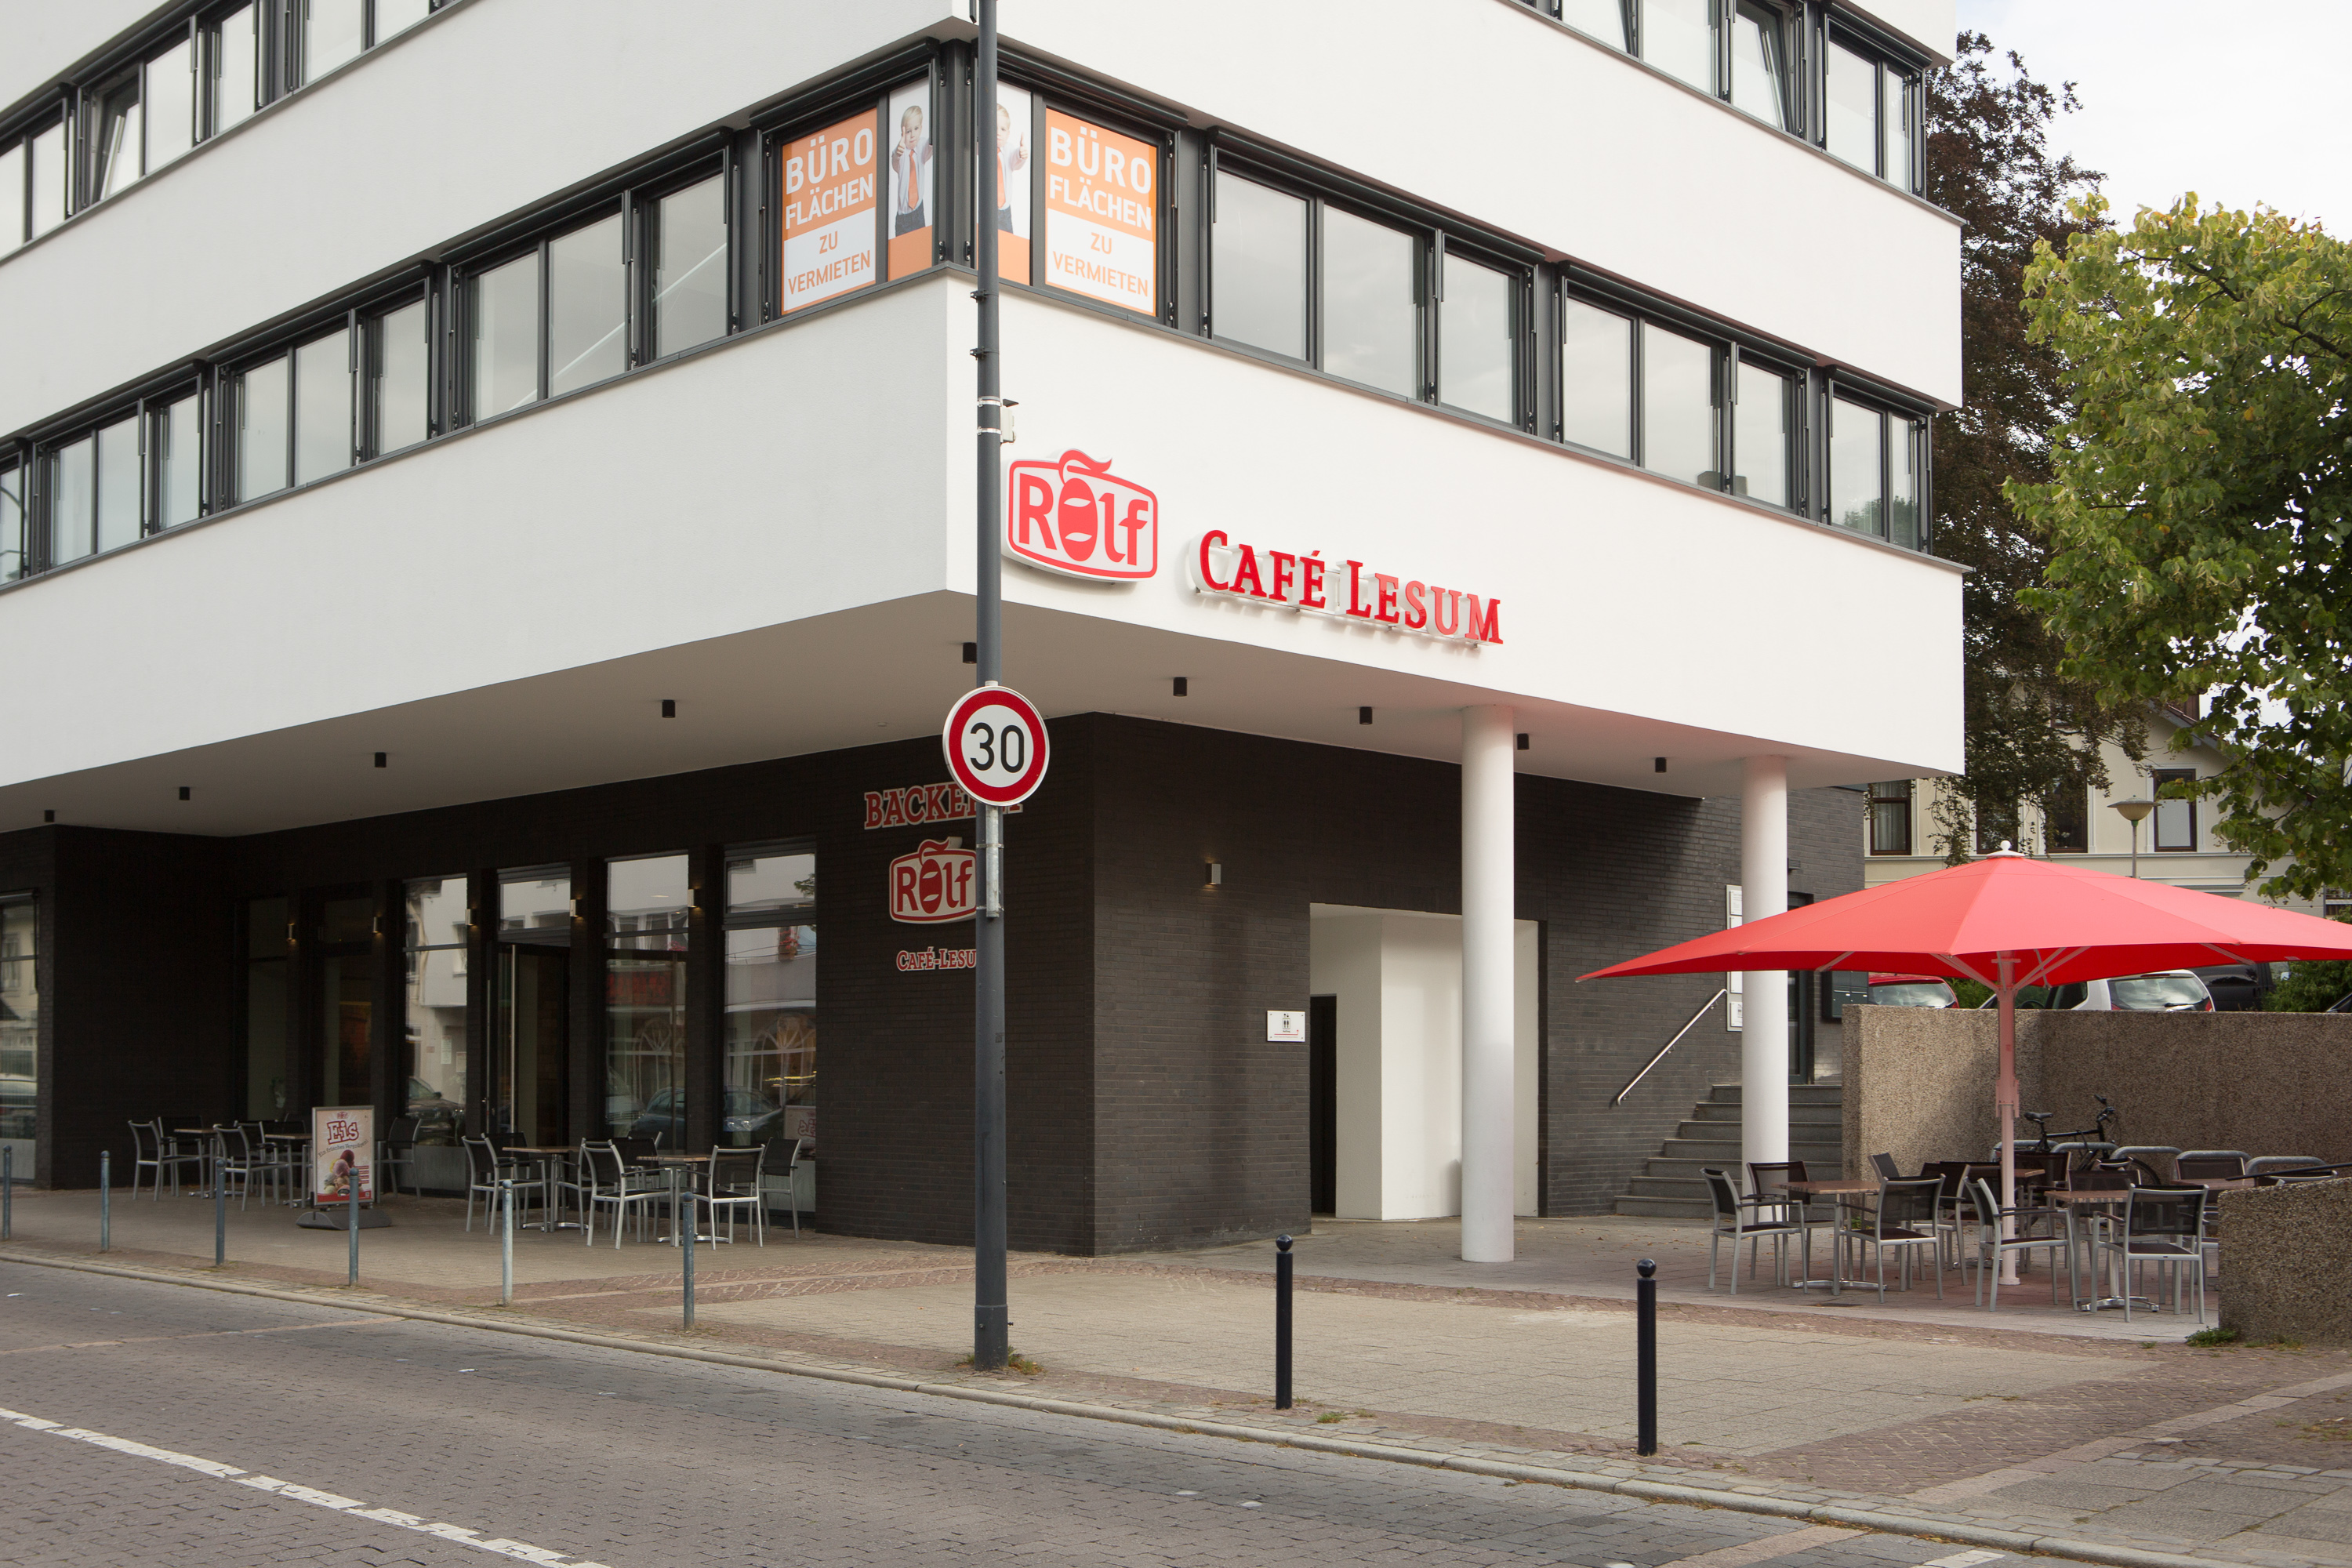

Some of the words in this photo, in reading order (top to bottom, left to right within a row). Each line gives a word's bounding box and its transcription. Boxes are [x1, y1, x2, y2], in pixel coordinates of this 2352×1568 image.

[786, 127, 873, 195] BÜRO
[1050, 125, 1152, 194] BÜRO
[785, 172, 873, 230] FLÄCHEN
[1049, 176, 1152, 231] FLÄCHEN
[818, 230, 839, 255] ZU
[1090, 231, 1113, 256] ZU
[787, 249, 871, 296] VERMIETEN
[1052, 250, 1149, 298] VERMIETEN
[1018, 471, 1150, 567] Rolf
[1198, 528, 1327, 610] CAFÉ
[1343, 558, 1504, 645] LESUM
[969, 721, 1025, 774] 30
[864, 782, 1023, 830] BÄCKE
[895, 858, 974, 915] Rolf
[896, 946, 977, 971] CAFÉ-LESU
[326, 1120, 359, 1145] Eis
